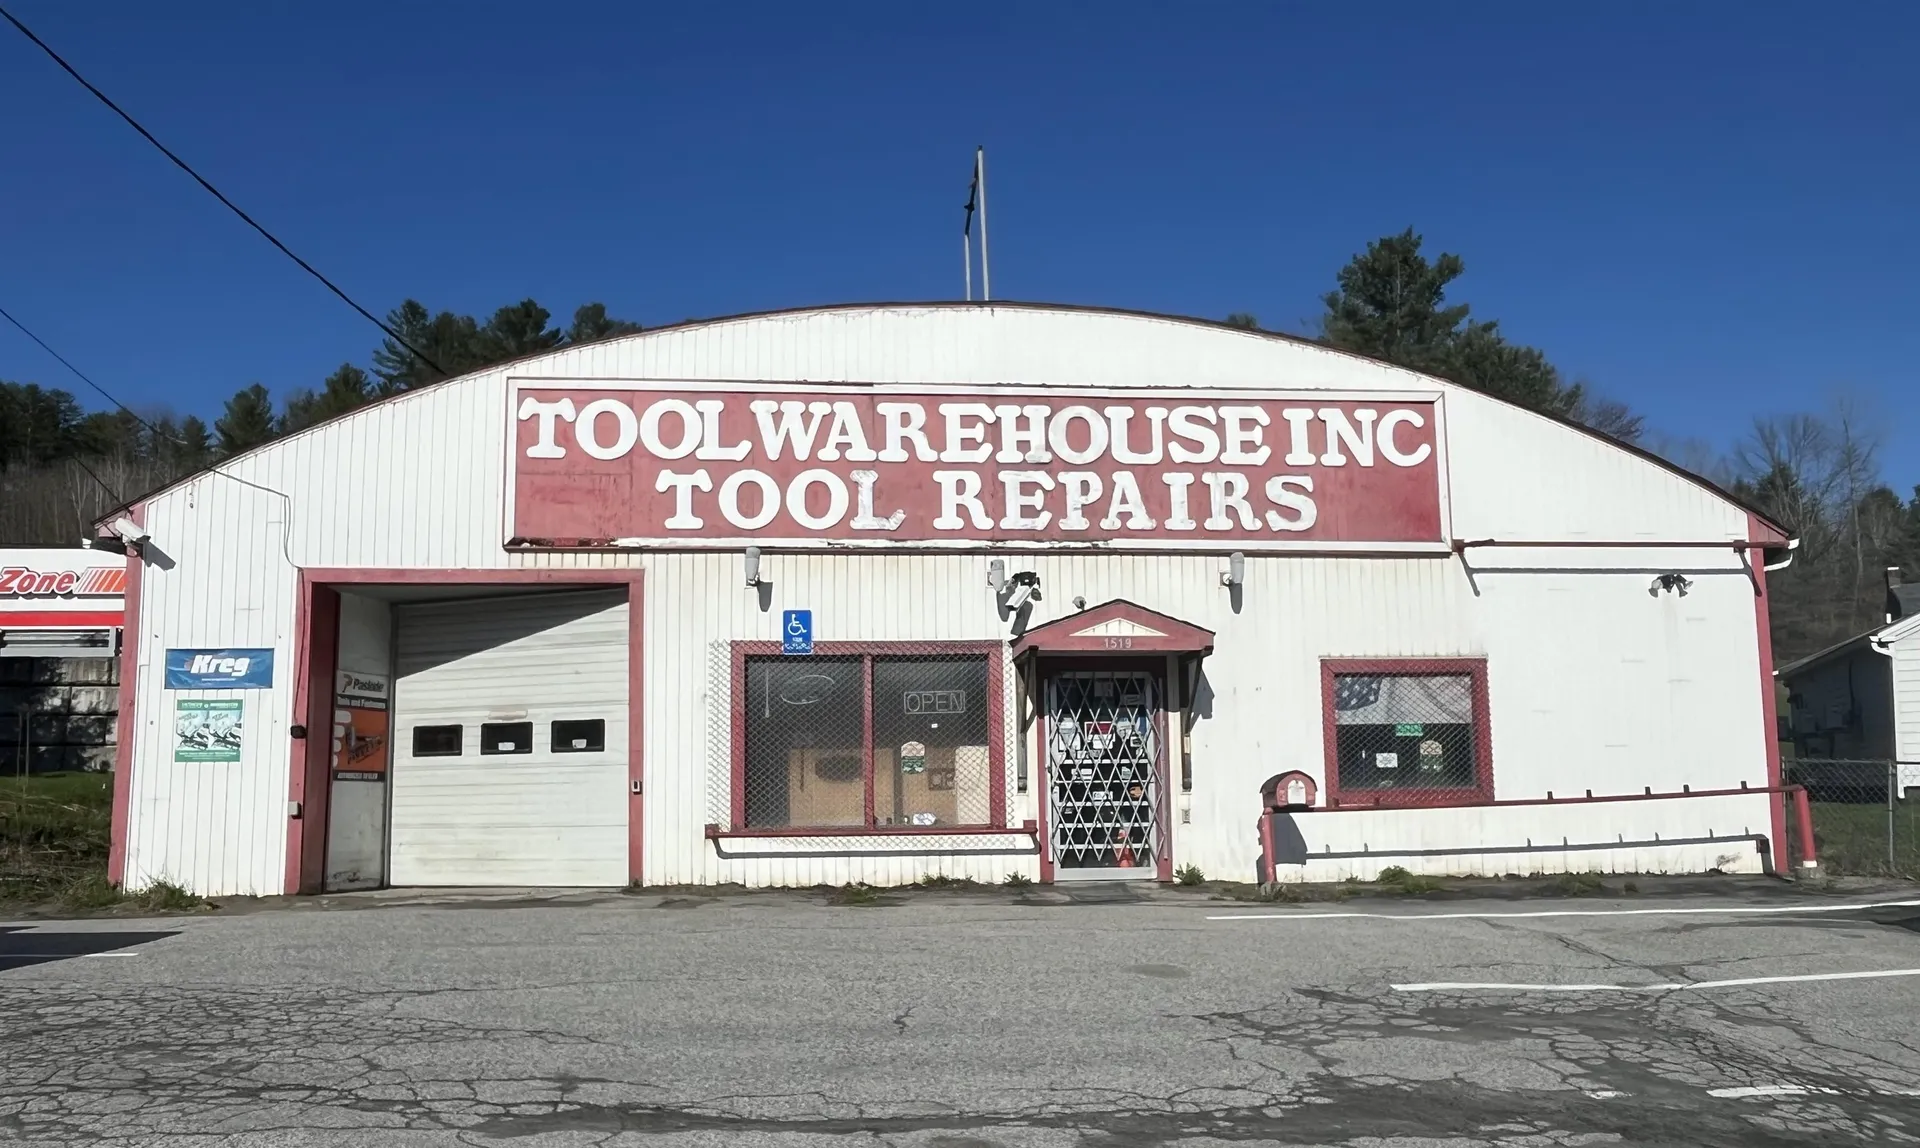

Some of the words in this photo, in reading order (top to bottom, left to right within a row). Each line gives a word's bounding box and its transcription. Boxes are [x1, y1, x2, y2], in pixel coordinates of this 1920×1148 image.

[518, 397, 752, 461] TOOL
[749, 399, 1272, 466] WAREHOUSE
[1282, 406, 1432, 468] INC
[655, 466, 907, 531] TOOL
[932, 467, 1317, 533] REPAIRS
[1104, 637, 1132, 649] 1519
[190, 654, 250, 677] Kreg
[907, 693, 963, 712] OPEN
